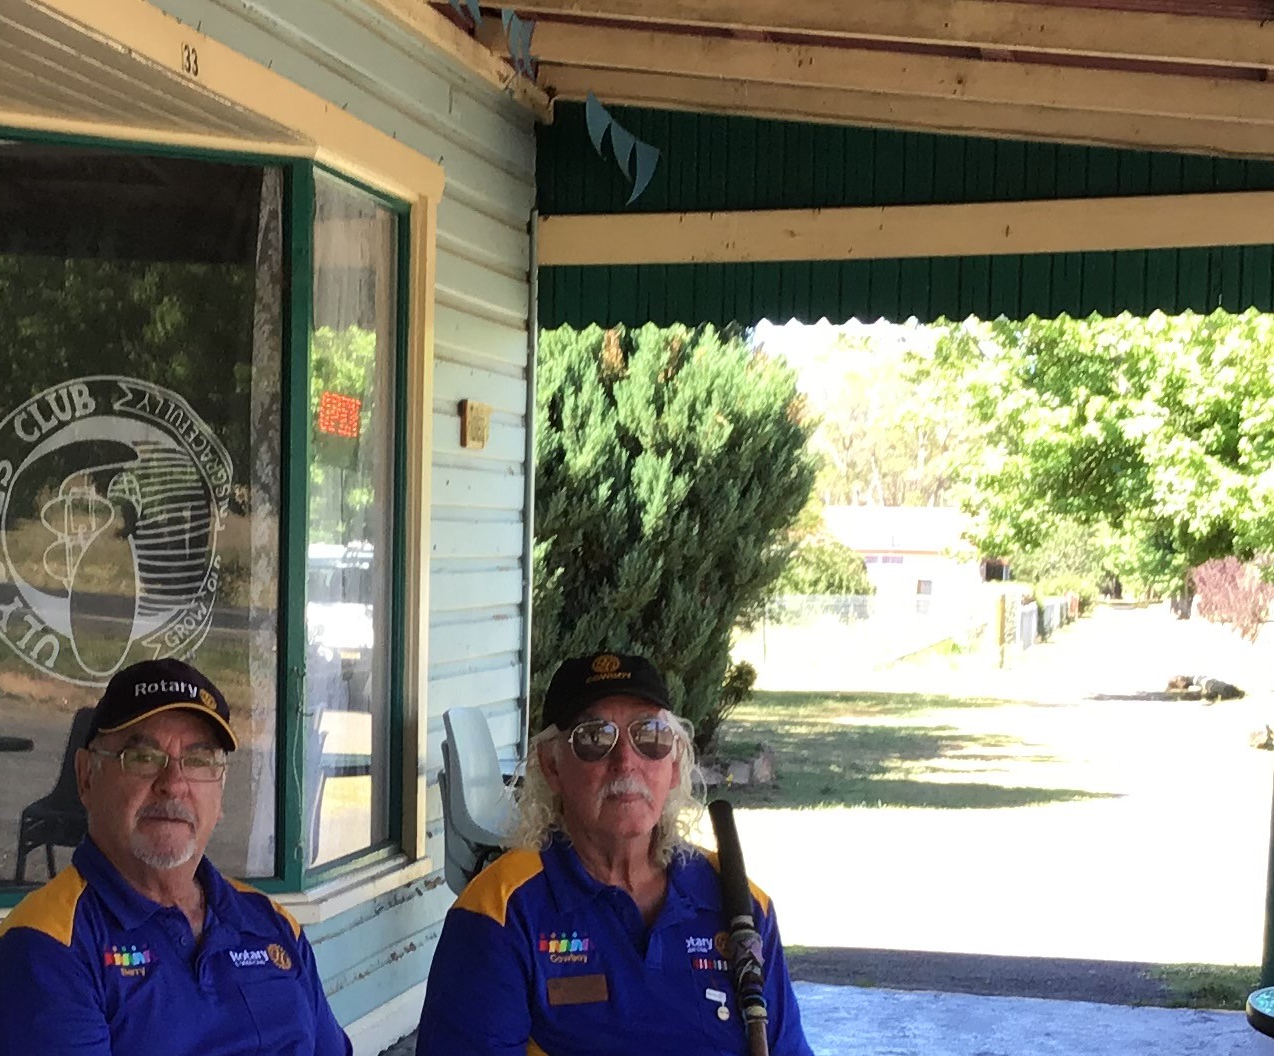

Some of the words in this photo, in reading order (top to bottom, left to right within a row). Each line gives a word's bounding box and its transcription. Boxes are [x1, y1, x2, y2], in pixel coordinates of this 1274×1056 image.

[14, 383, 96, 442] CLUB
[165, 601, 207, 648] GROW
[134, 679, 200, 698] Rotary
